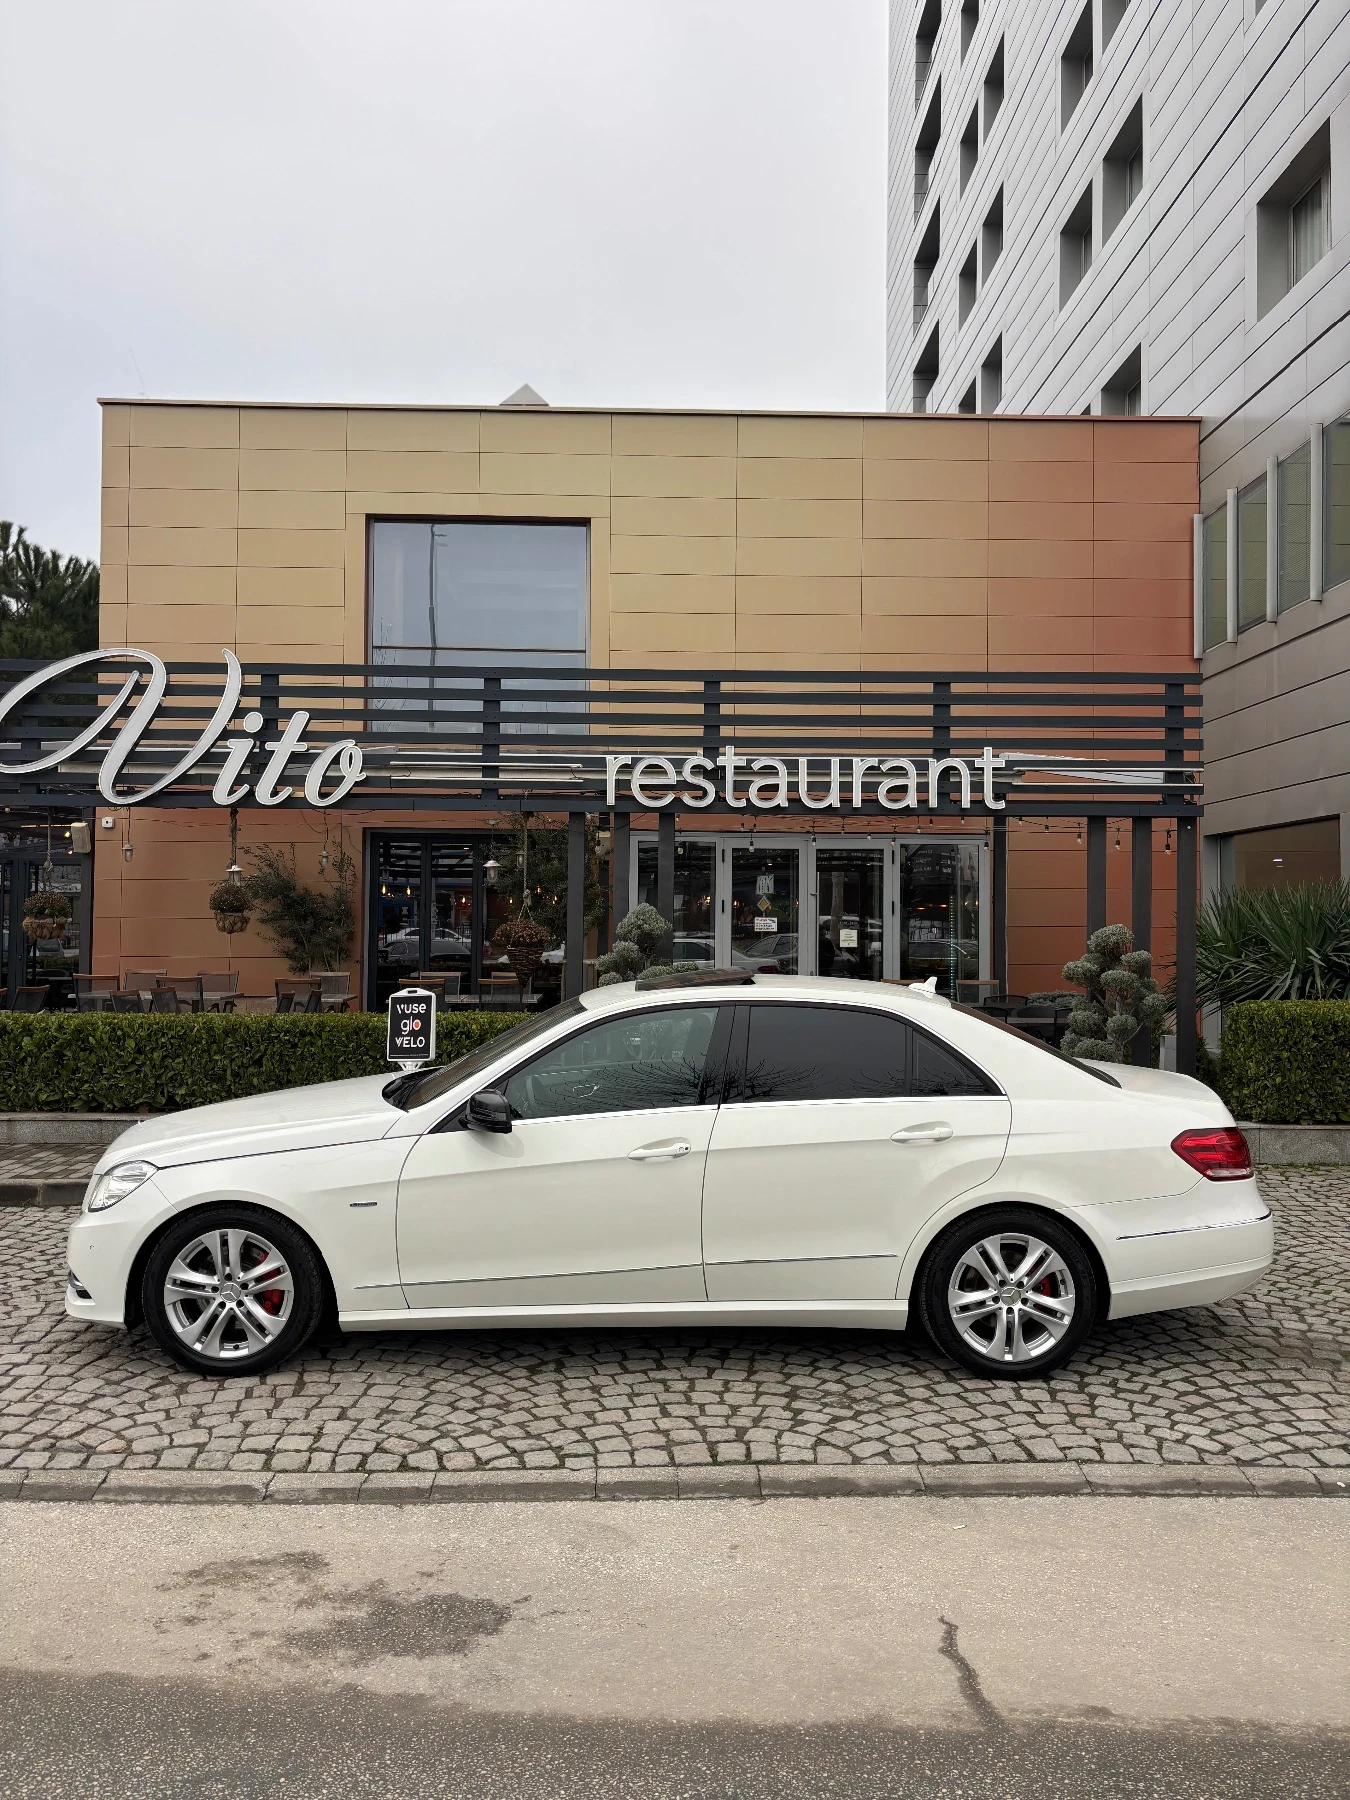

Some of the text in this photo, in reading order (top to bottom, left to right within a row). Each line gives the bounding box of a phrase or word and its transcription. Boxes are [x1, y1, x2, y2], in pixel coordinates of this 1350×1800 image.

[0, 648, 1006, 809] Vito restaurant
[396, 1003, 427, 1014] vuse
[400, 1015, 421, 1035] glo
[395, 1036, 425, 1048] VELO
